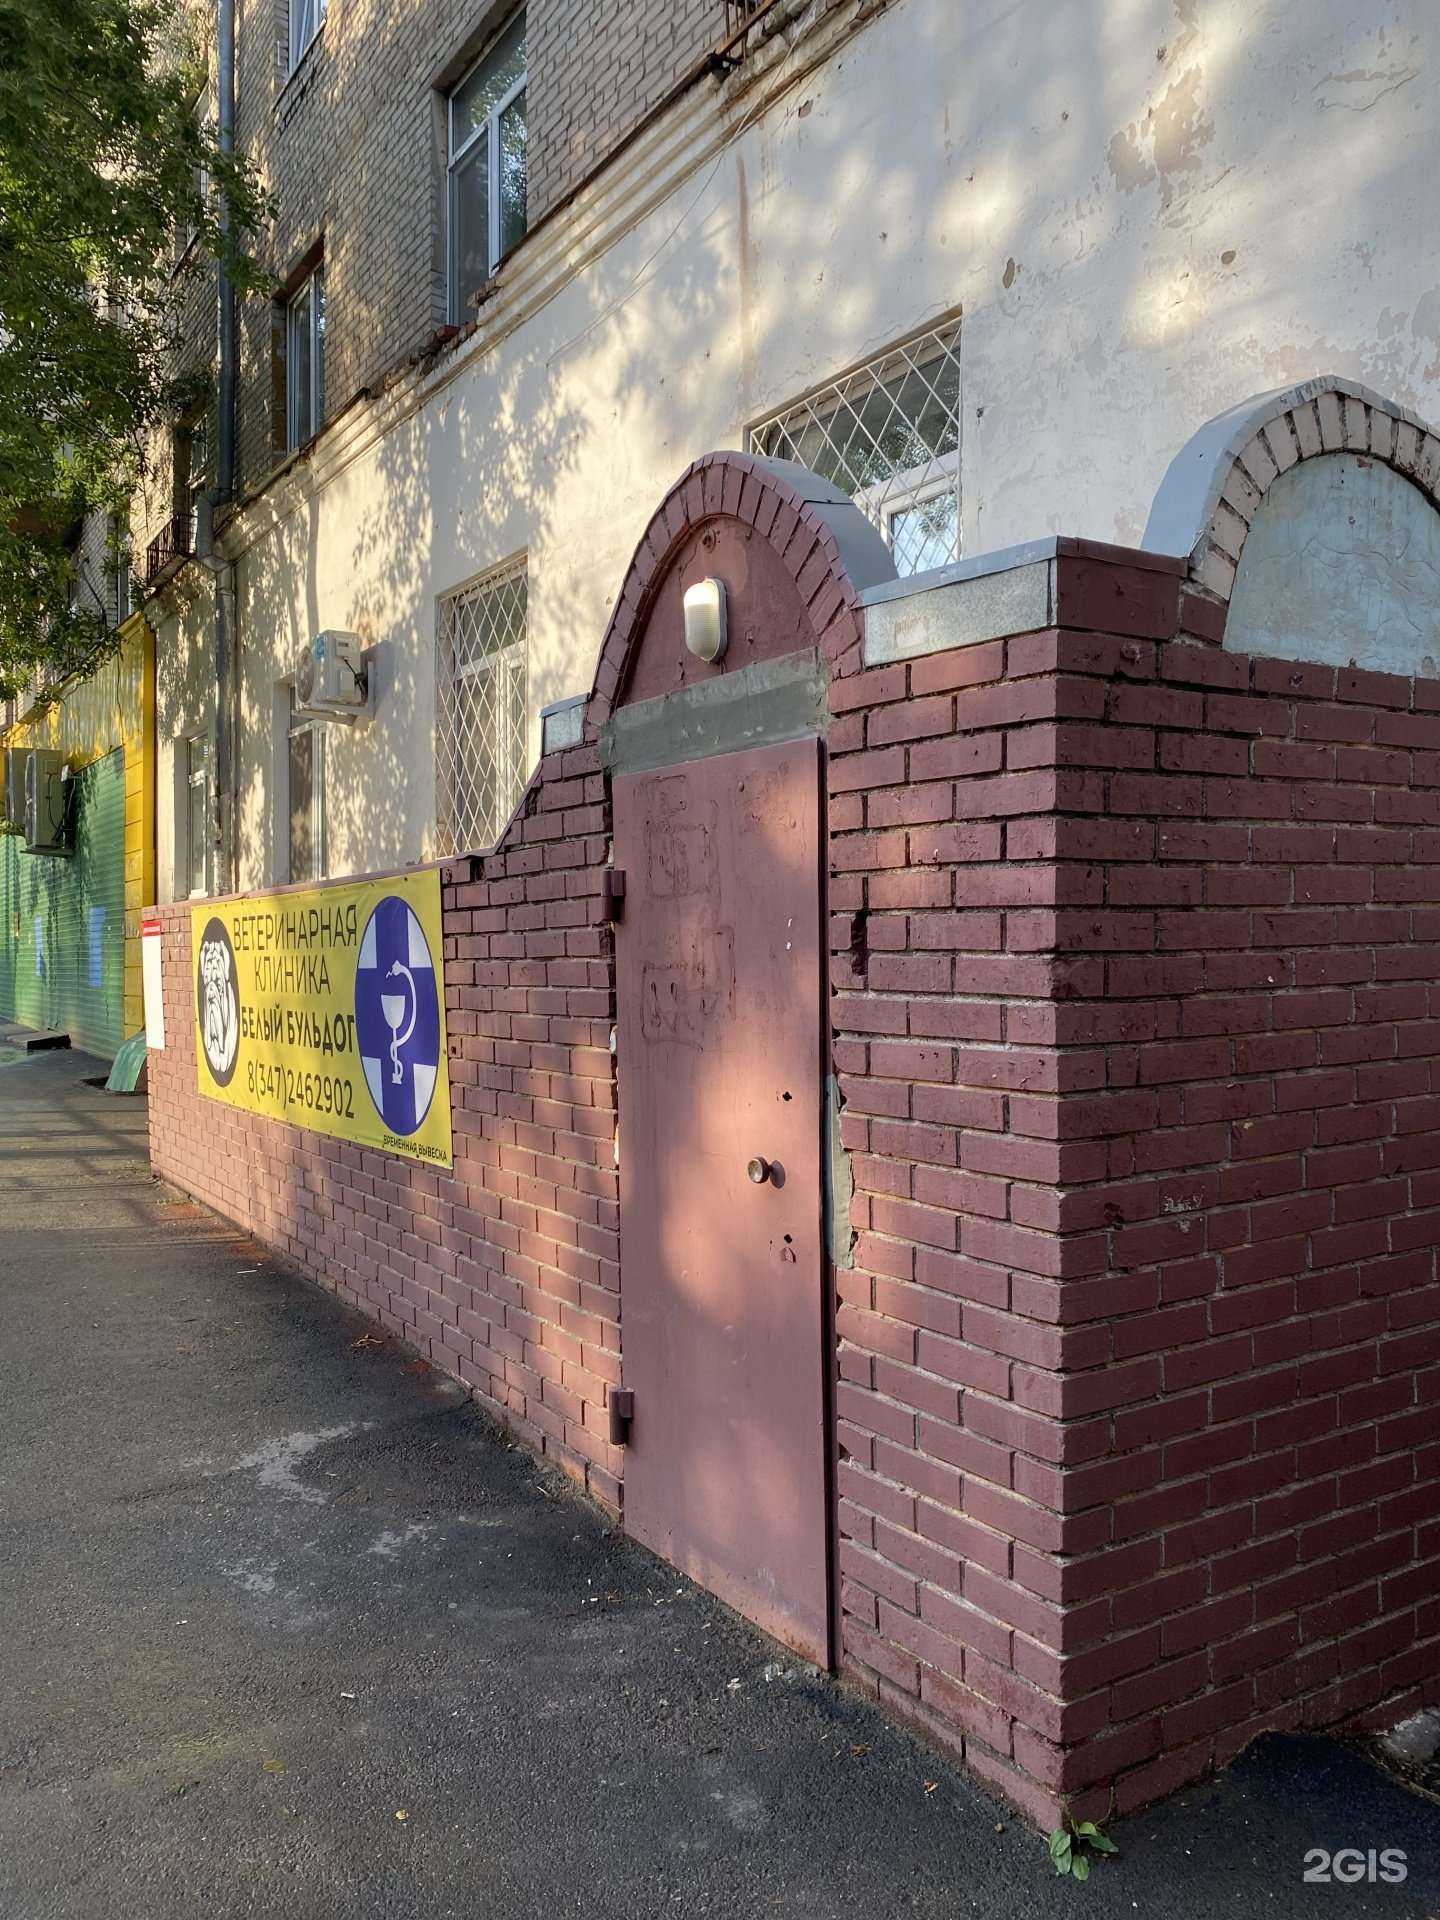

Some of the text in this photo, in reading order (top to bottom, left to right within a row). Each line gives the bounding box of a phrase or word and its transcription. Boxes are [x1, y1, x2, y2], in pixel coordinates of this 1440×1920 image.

[233, 904, 358, 951] ВЕТЕРИНАРНАЯ
[255, 954, 331, 994] КЛИНИКА
[241, 1003, 354, 1056] БЕЛЫЙ БУЛЬДОГ
[248, 1060, 354, 1118] 8(347)2462902
[383, 1134, 447, 1162] ВРЕМЕННАЯ ВЫВЕСКА
